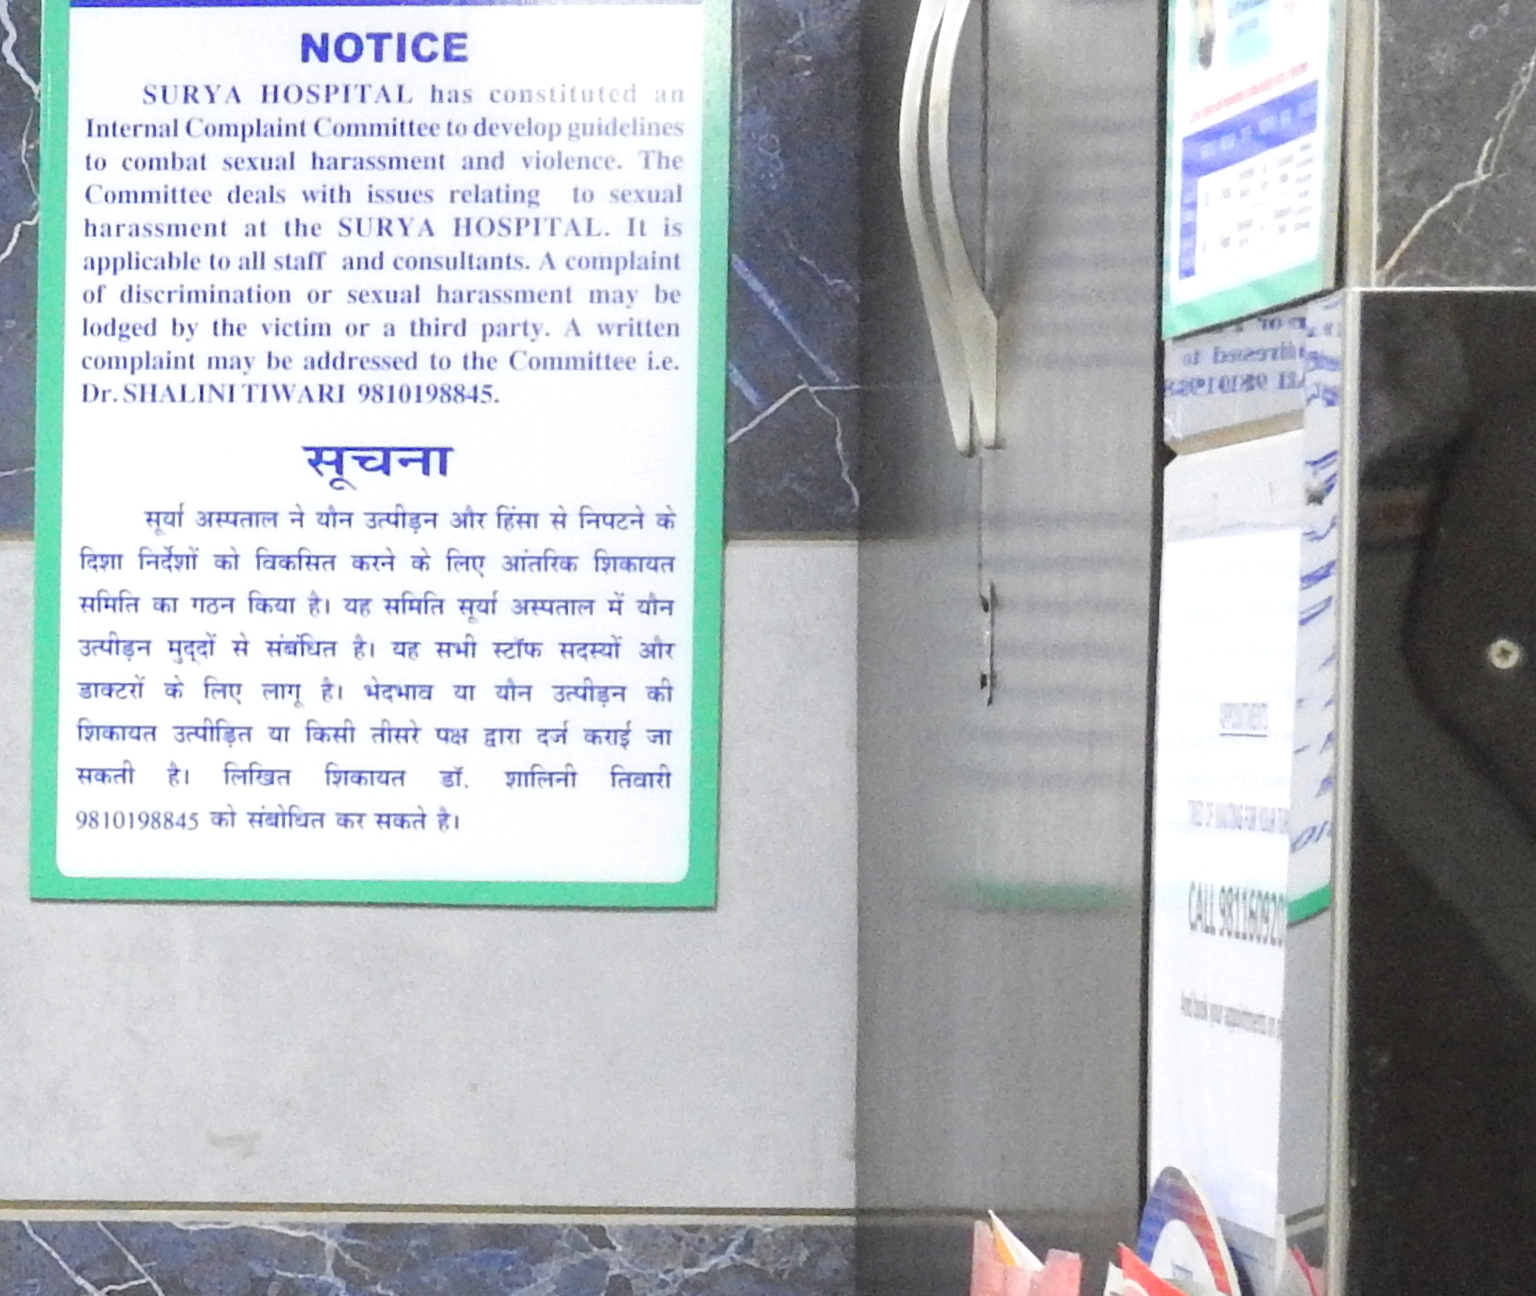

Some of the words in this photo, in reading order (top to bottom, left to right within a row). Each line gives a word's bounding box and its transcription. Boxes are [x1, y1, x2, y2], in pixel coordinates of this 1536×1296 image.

[300, 30, 469, 65] NOTICE
[85, 152, 107, 172] to
[121, 149, 207, 172] combat
[222, 149, 295, 172] sexual
[311, 150, 445, 172] harassment
[461, 149, 505, 172] and
[521, 149, 622, 171] violence.
[639, 150, 683, 171] The
[84, 216, 228, 238] harassment
[244, 218, 267, 238] at
[284, 216, 322, 238] the
[338, 216, 435, 238] SURYA
[454, 216, 610, 238] HOSPITAL.
[627, 216, 647, 238] It
[663, 216, 683, 238] is
[81, 348, 195, 376] complaint
[207, 354, 256, 376] may
[266, 349, 293, 371] be
[303, 349, 418, 371] addressed
[429, 351, 452, 371] to
[462, 349, 498, 372] the
[508, 349, 637, 371] Committee
[647, 349, 679, 371] i.e.
[357, 383, 500, 405] 9810198845.
[301, 445, 456, 492] सूचना
[143, 501, 185, 537] सूर्या
[287, 502, 306, 529] ने
[314, 503, 355, 529] यौन
[362, 502, 440, 536] उत्पीड़न
[449, 504, 489, 531] और
[495, 503, 541, 533] हिंसा
[548, 504, 569, 531] से
[577, 504, 646, 532] निपटने
[655, 503, 677, 531] के
